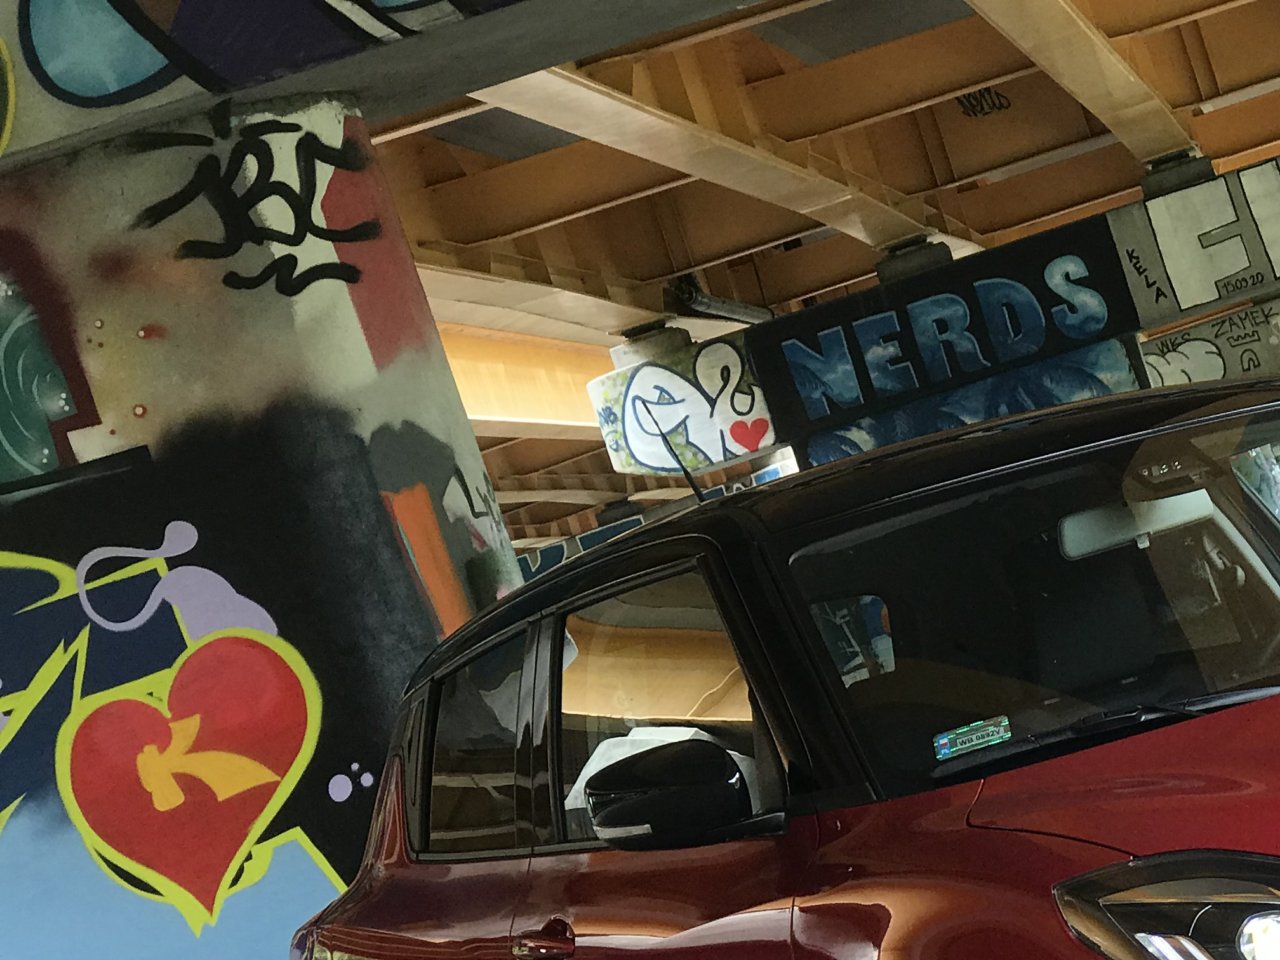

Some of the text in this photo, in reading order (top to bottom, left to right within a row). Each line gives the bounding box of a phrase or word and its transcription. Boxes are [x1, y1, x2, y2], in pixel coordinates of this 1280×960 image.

[1126, 249, 1167, 304] KELA
[781, 254, 1108, 421] NERDS
[1211, 306, 1279, 339] ZAMEK
